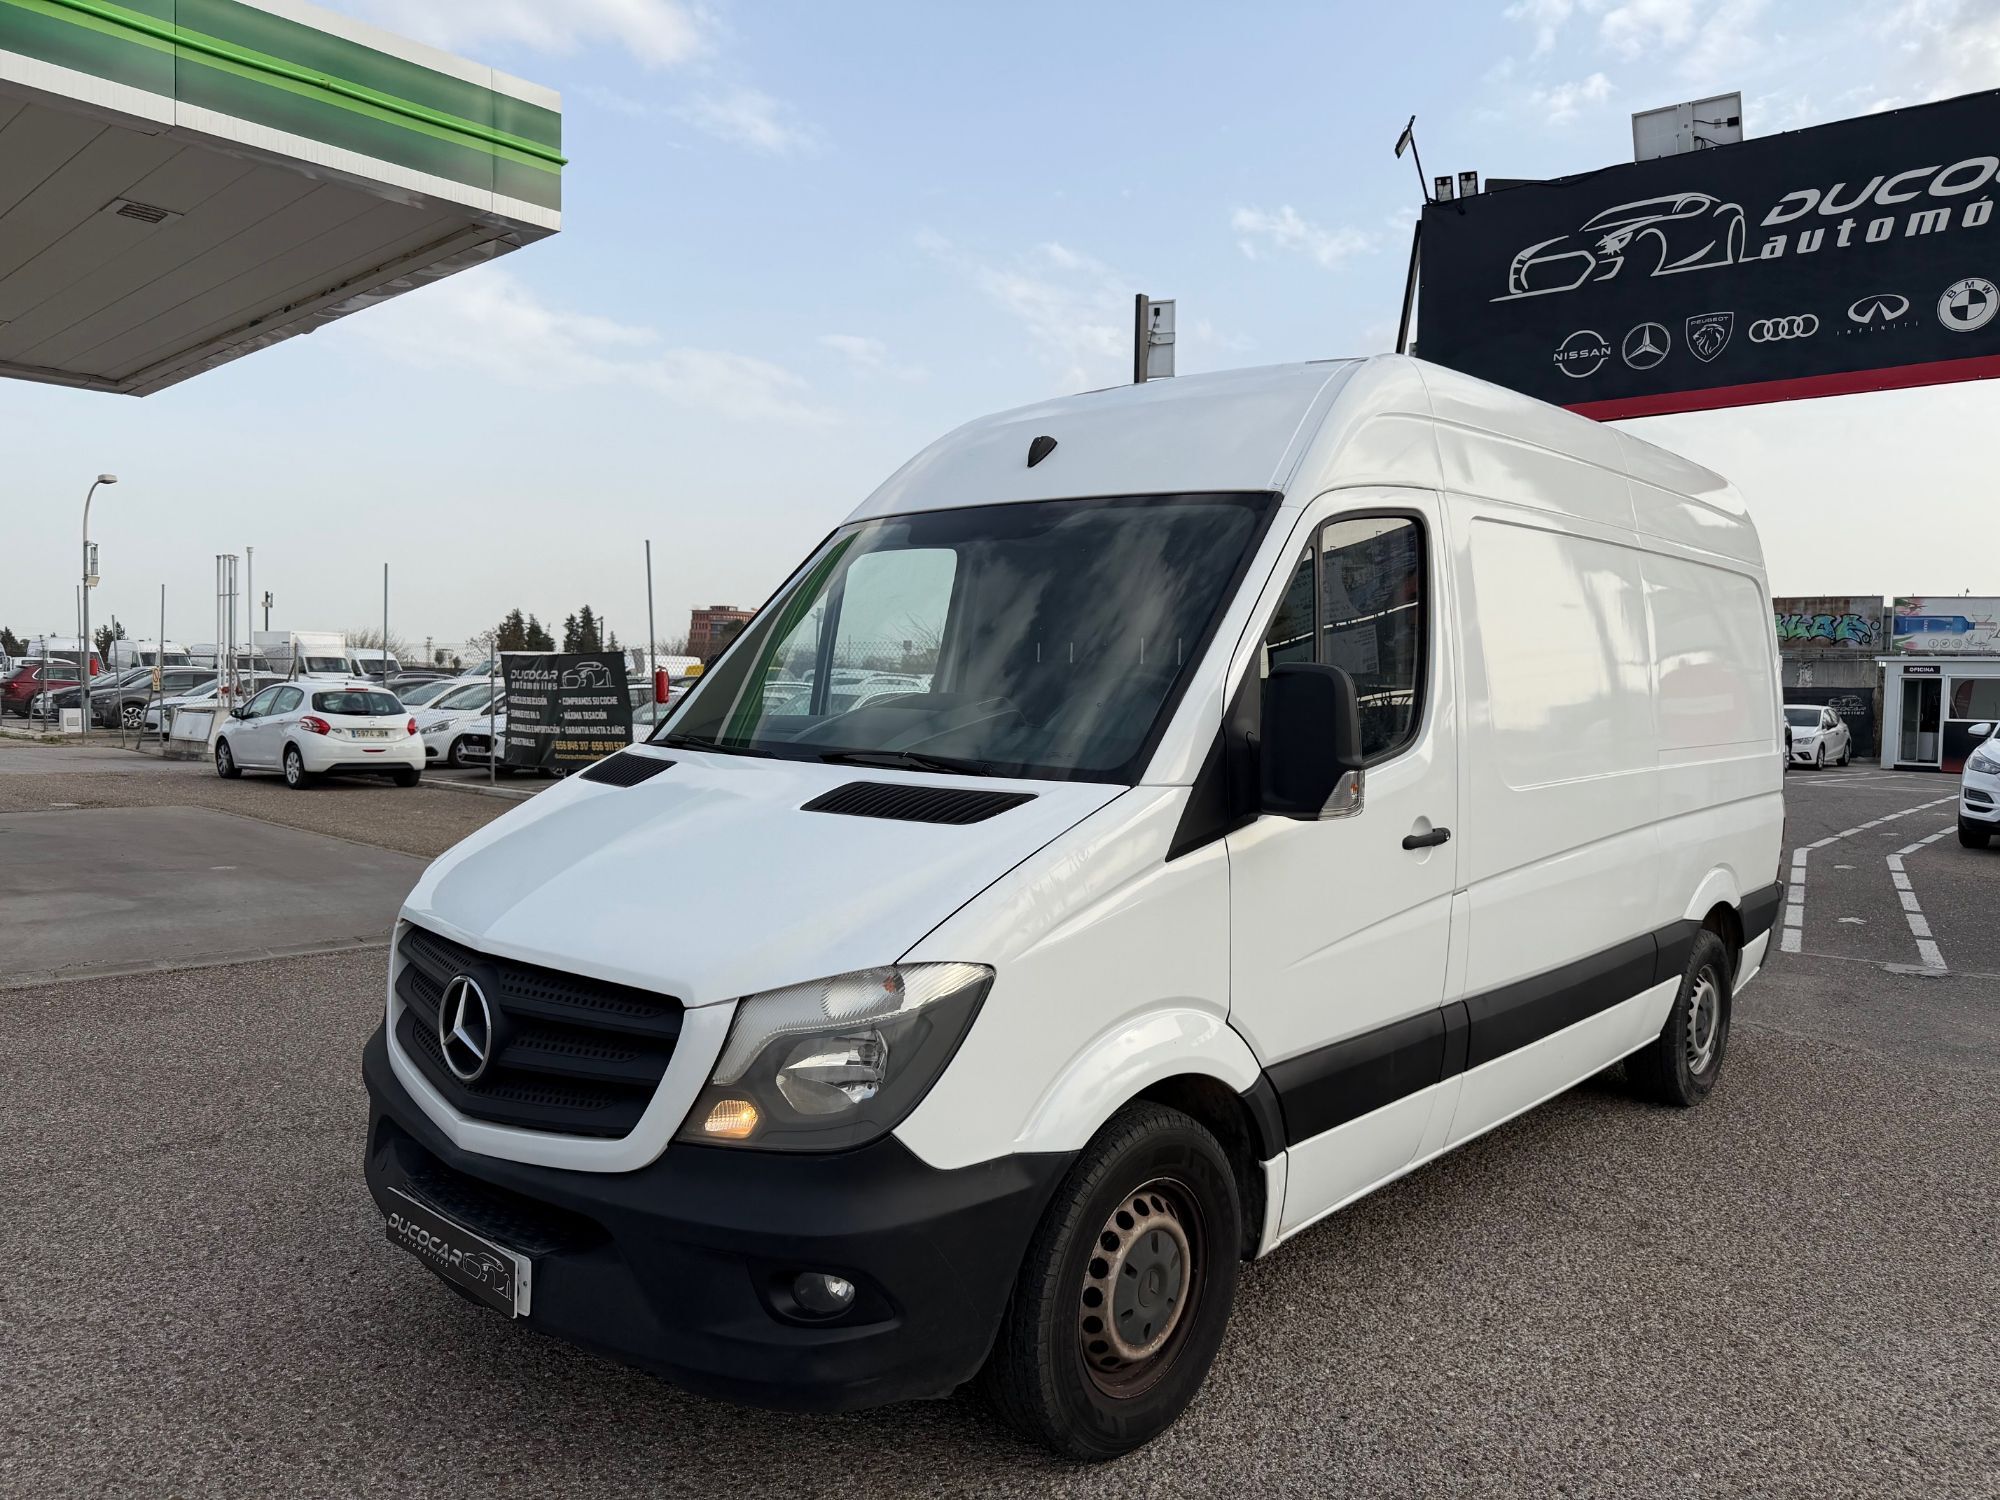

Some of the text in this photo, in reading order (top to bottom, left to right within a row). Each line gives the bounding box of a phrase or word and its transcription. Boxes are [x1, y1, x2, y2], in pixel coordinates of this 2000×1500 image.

[1760, 156, 2000, 227] DUCO
[1947, 280, 1994, 299] BMW
[1691, 316, 1729, 325] PEUGEOT
[1836, 320, 1919, 336] INFINITI
[1553, 345, 1612, 363] NISSAN
[511, 669, 559, 680] DUCOCAR
[562, 696, 618, 705] COMPRAMOS SU COCHE
[582, 709, 607, 719] TASACIÓN
[590, 726, 606, 734] HASTA
[611, 725, 626, 734] AÑOS
[388, 1213, 463, 1267] DUCOCAR
